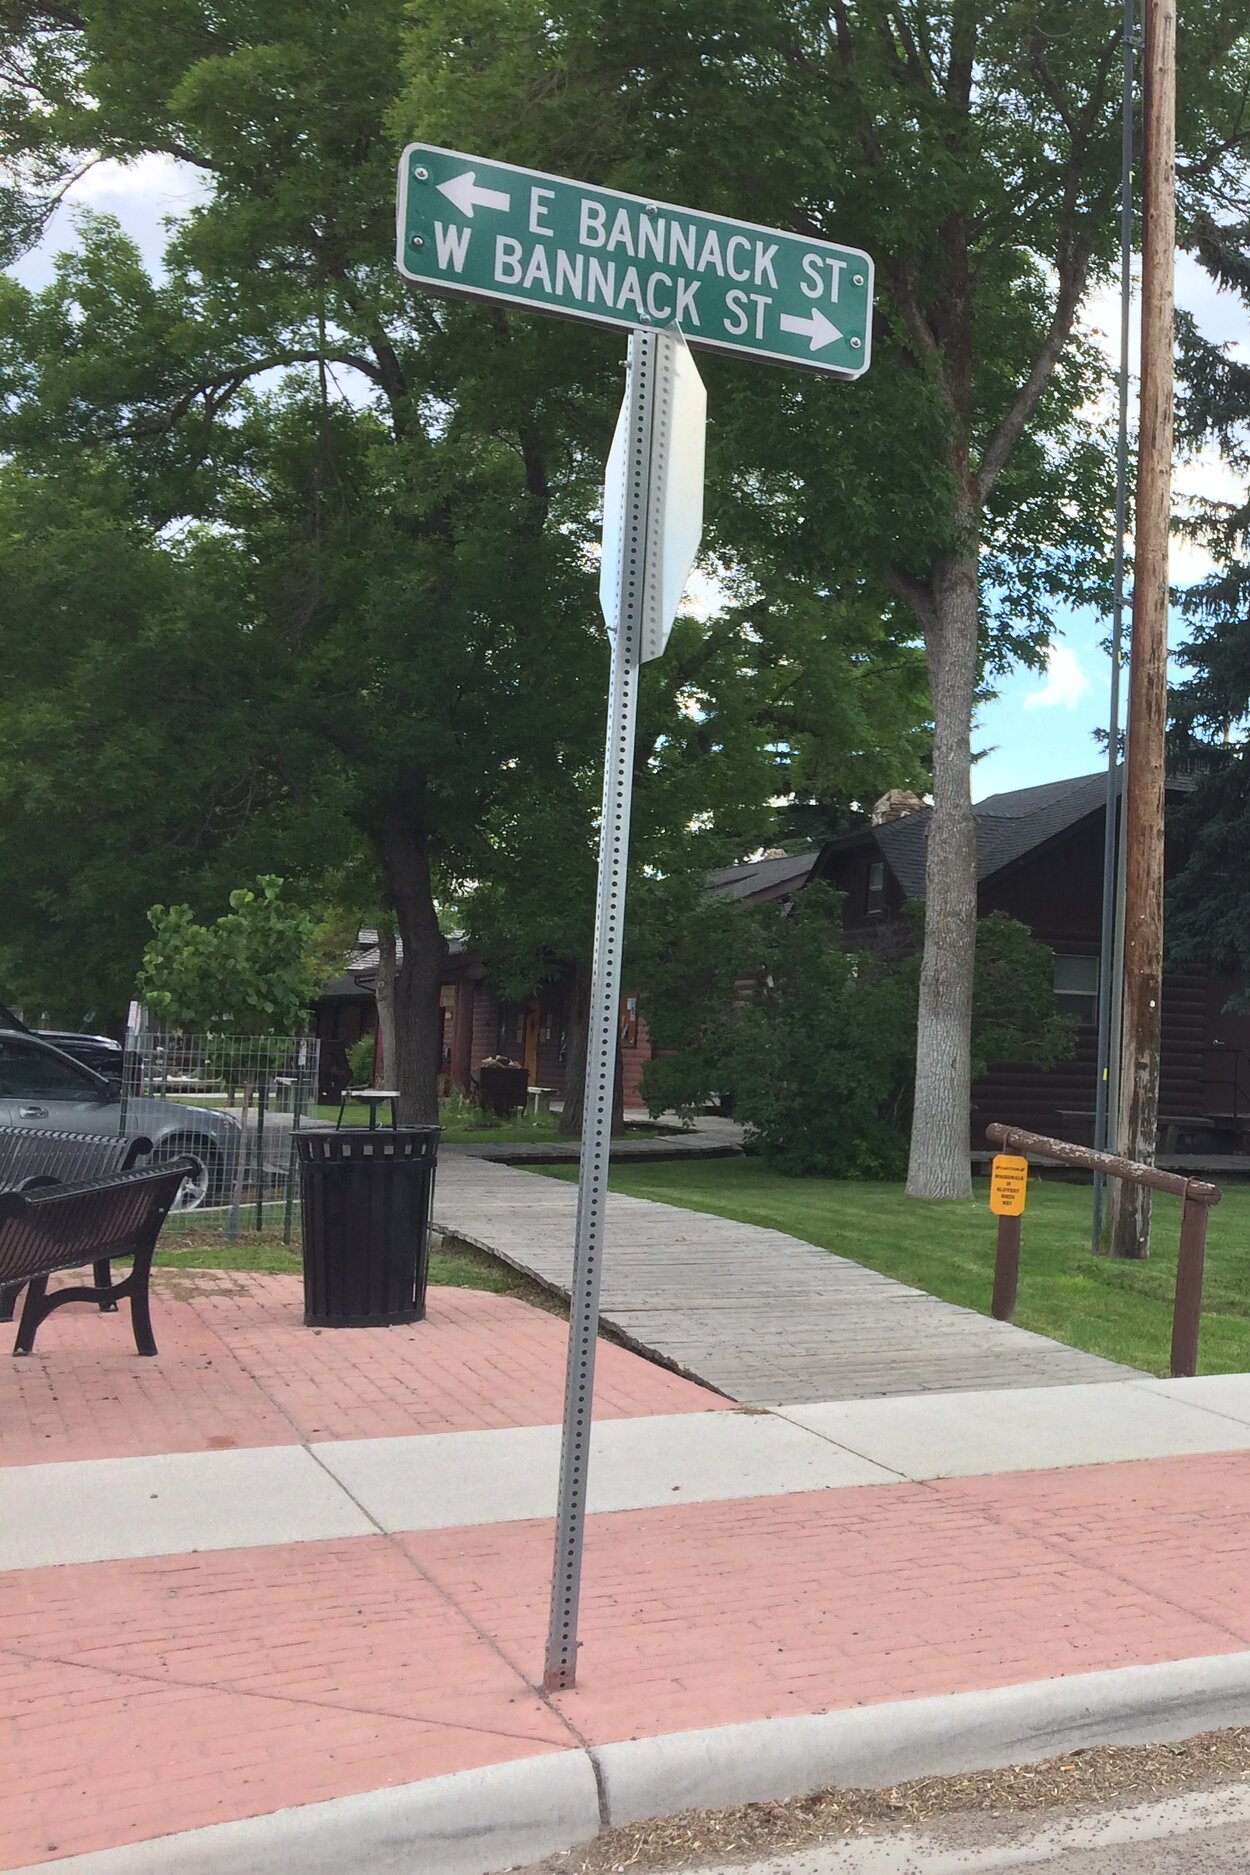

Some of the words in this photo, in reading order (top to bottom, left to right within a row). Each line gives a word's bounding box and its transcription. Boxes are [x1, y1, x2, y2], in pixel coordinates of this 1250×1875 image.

[434, 221, 472, 273] W
[494, 235, 701, 326] BANNACK
[723, 289, 773, 340] ST
[529, 186, 555, 237] E
[579, 198, 779, 290] BANNACK
[800, 253, 847, 303] ST
